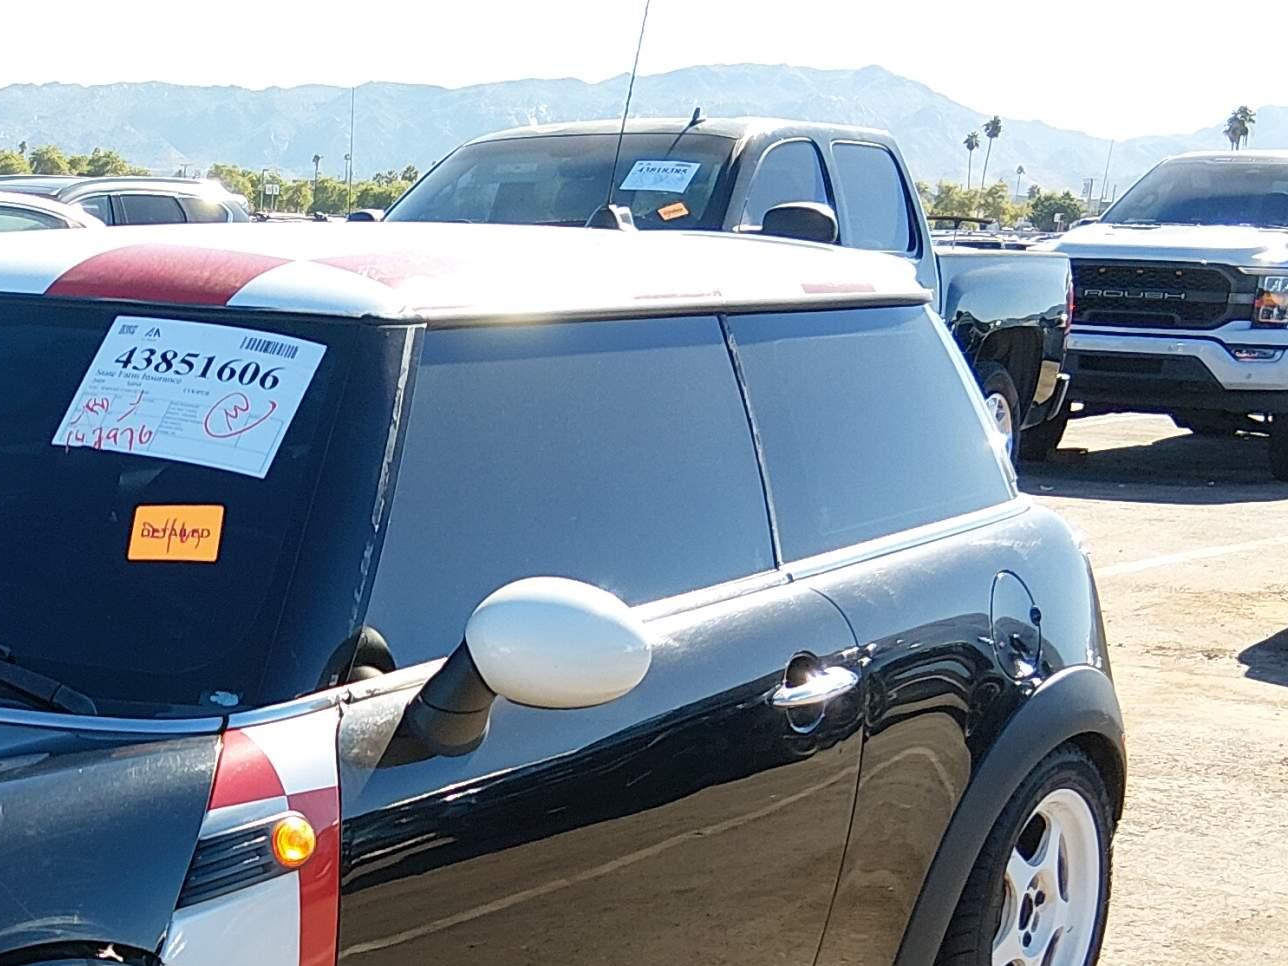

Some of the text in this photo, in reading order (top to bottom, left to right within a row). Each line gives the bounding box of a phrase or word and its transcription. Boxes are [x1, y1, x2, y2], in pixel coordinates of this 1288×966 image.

[1083, 288, 1186, 301] ROUSH
[114, 345, 287, 391] 43851606
[118, 369, 141, 381] Farm
[141, 373, 183, 386] Insurance
